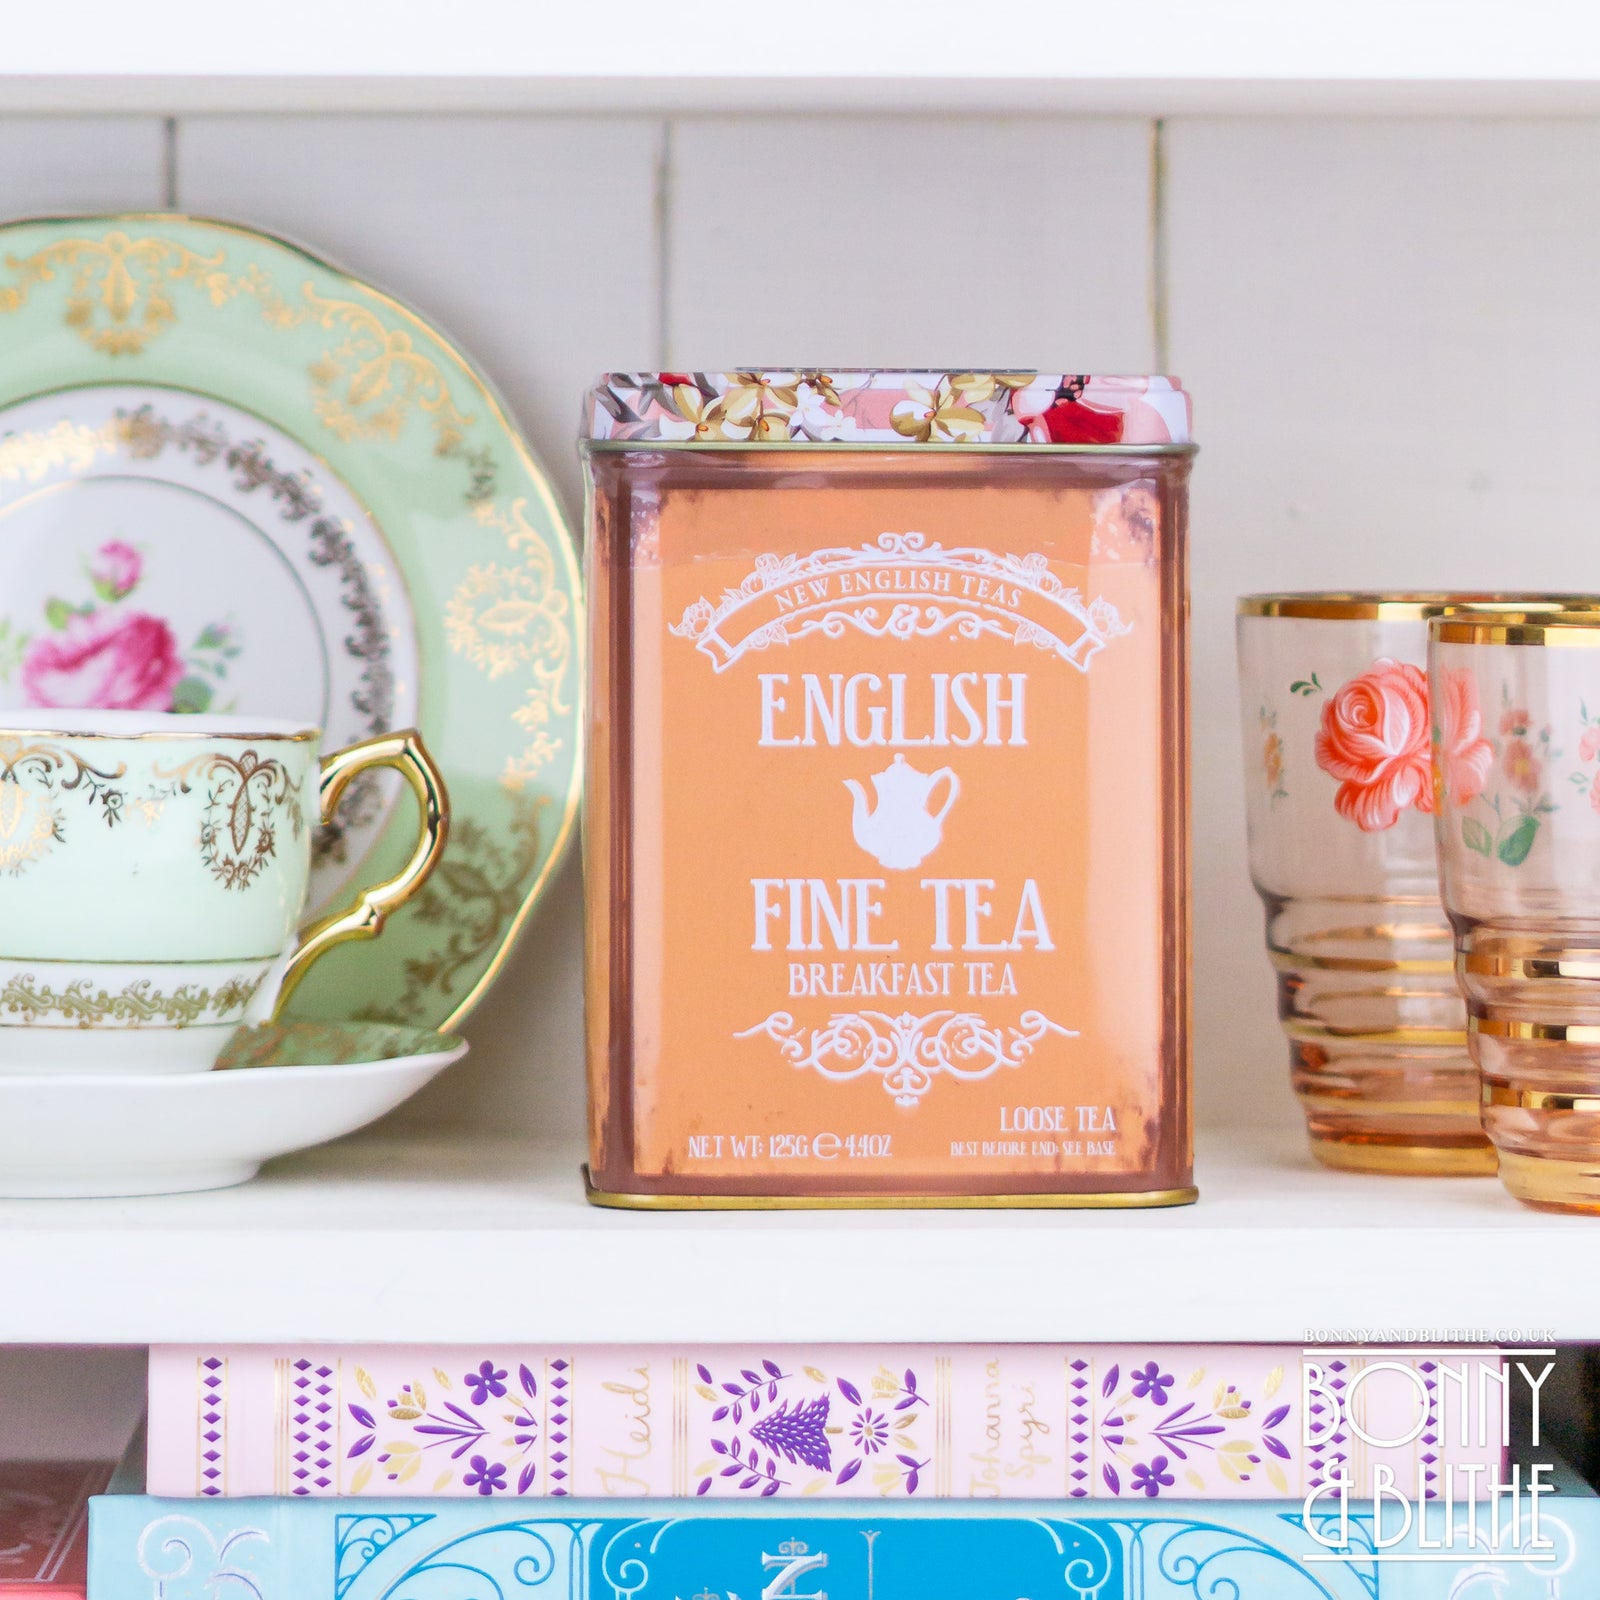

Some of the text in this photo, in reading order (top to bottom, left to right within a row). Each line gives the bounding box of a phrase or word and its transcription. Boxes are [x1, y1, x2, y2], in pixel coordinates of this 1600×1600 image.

[774, 569, 1022, 612] NEW ENGLISH TEAS
[758, 673, 1027, 746] ENGLISH
[751, 878, 1055, 952] FINE TEA
[788, 963, 1018, 996] BREAKFAST TEA
[688, 1135, 724, 1159] NET
[730, 1135, 764, 1159] WT:
[1000, 1106, 1117, 1132] LOOSE TEA
[950, 1141, 1116, 1156] BEST BEFORE END: SEE BASE
[593, 1360, 652, 1497] Heidi
[968, 1358, 1000, 1497] Johanna
[1004, 1382, 1051, 1479] Spyri
